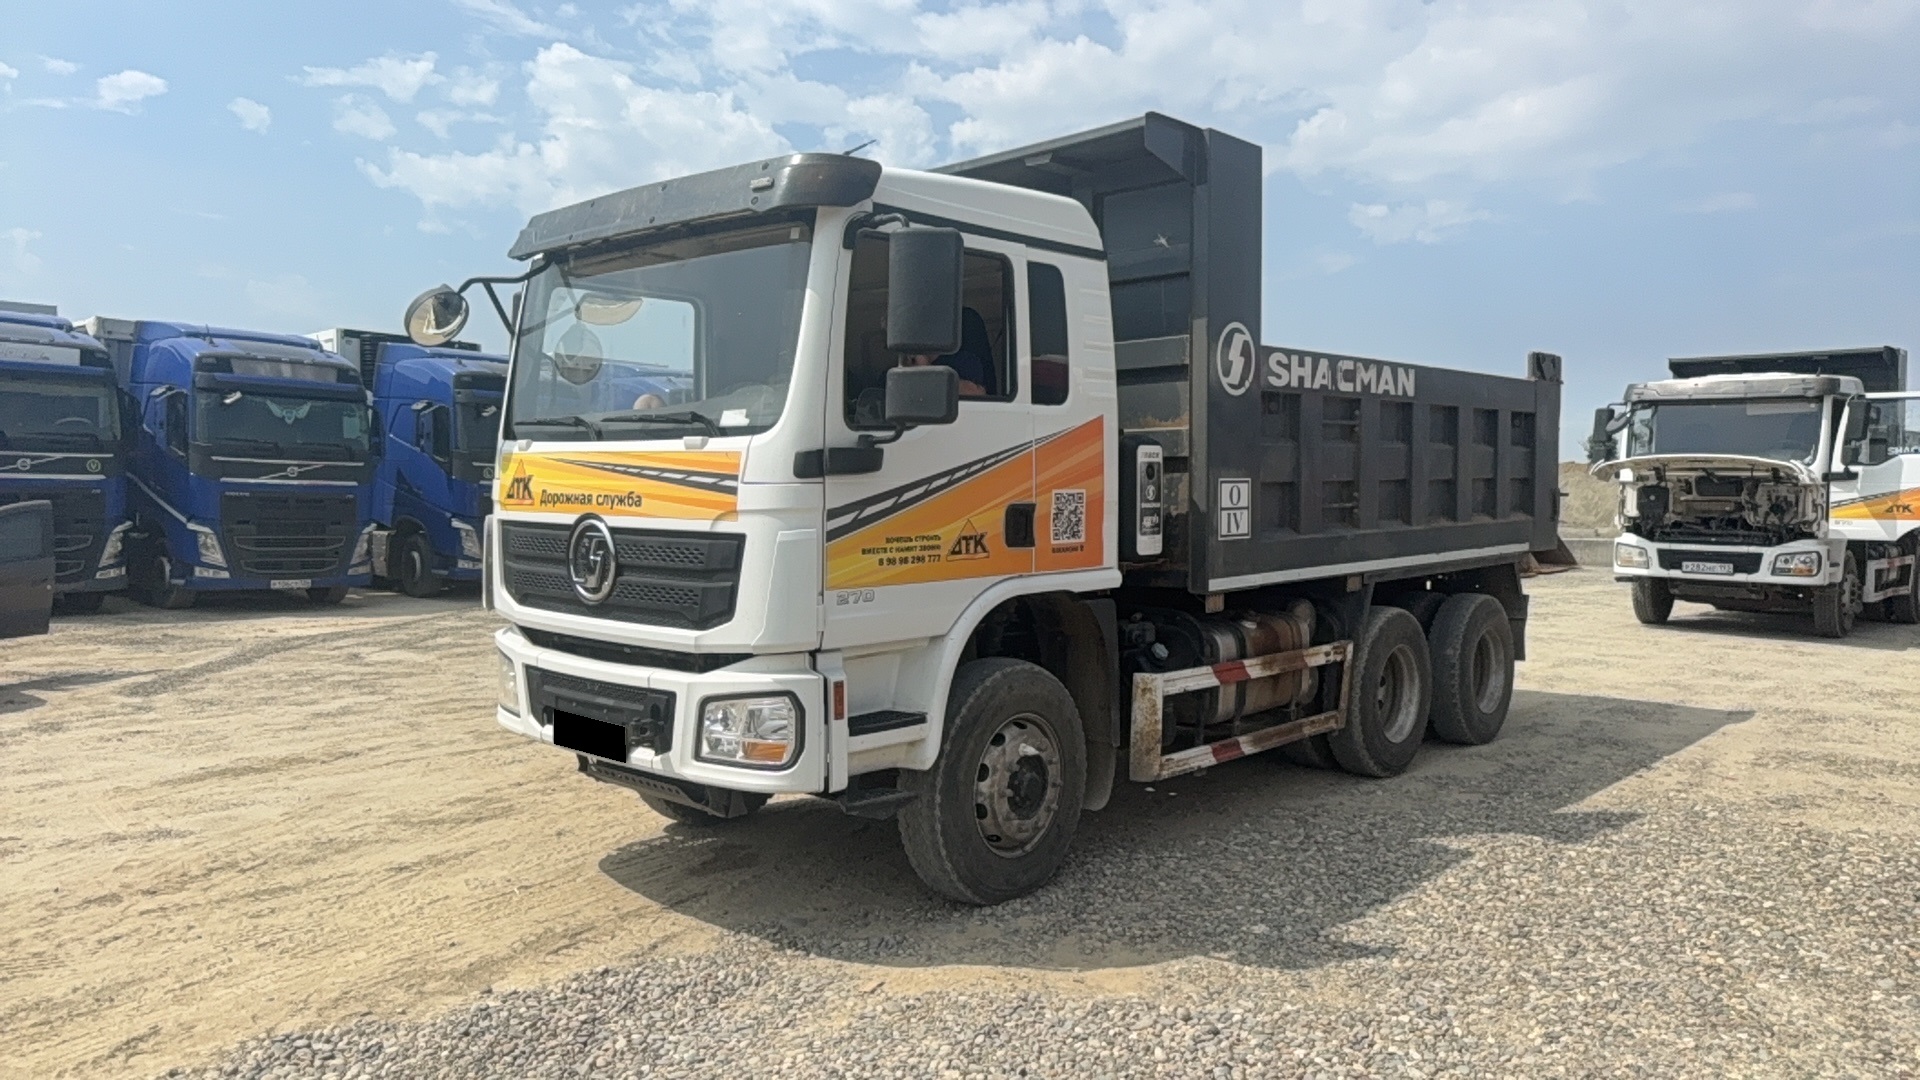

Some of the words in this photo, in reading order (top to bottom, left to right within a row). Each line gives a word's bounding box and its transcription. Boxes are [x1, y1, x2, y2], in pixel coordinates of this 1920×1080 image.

[1267, 351, 1416, 397] SHACMAN
[540, 489, 593, 507] Дорожная
[596, 491, 642, 510] служба
[1227, 511, 1244, 533] IV
[928, 554, 941, 562] 777
[836, 589, 875, 606] 270
